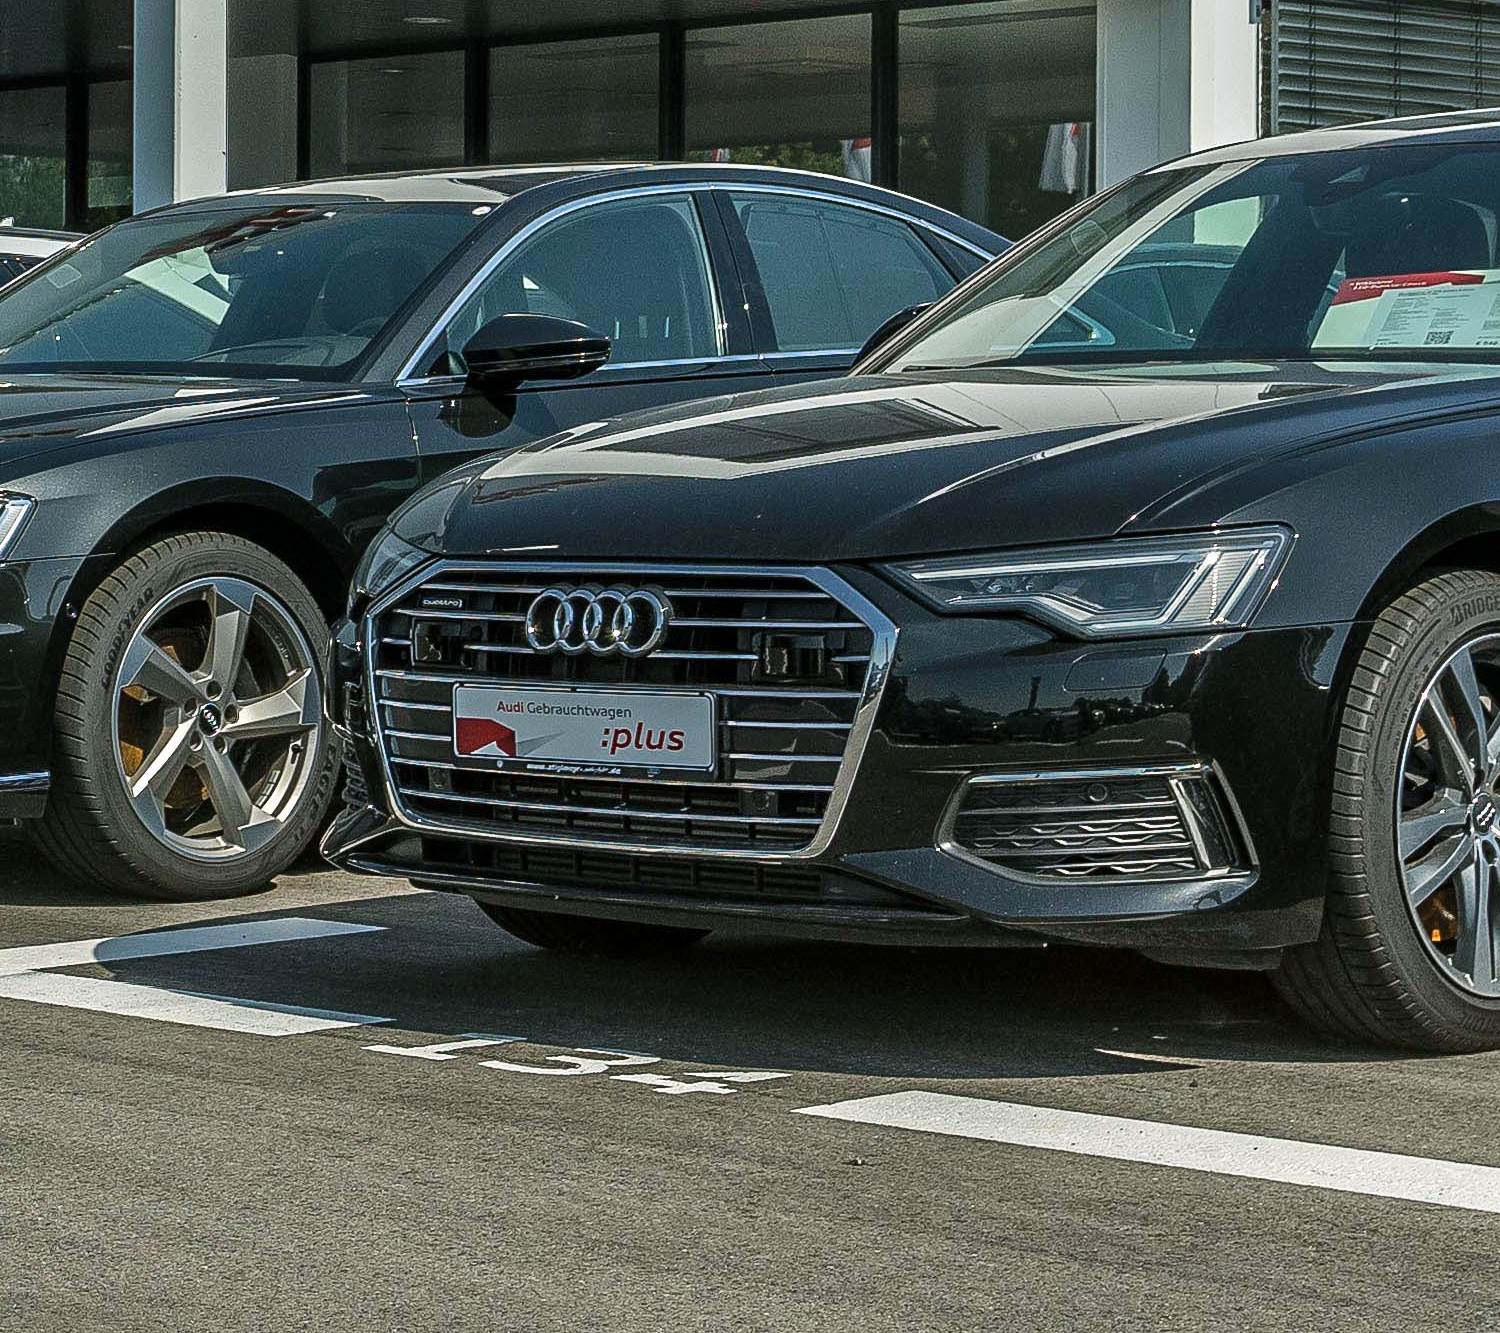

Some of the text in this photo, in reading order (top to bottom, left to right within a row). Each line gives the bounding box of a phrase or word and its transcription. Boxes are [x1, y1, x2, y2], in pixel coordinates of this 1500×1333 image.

[496, 700, 632, 720] Audi Gebrauchtwagen
[601, 722, 685, 755] :plus
[361, 1033, 793, 1094] 134
